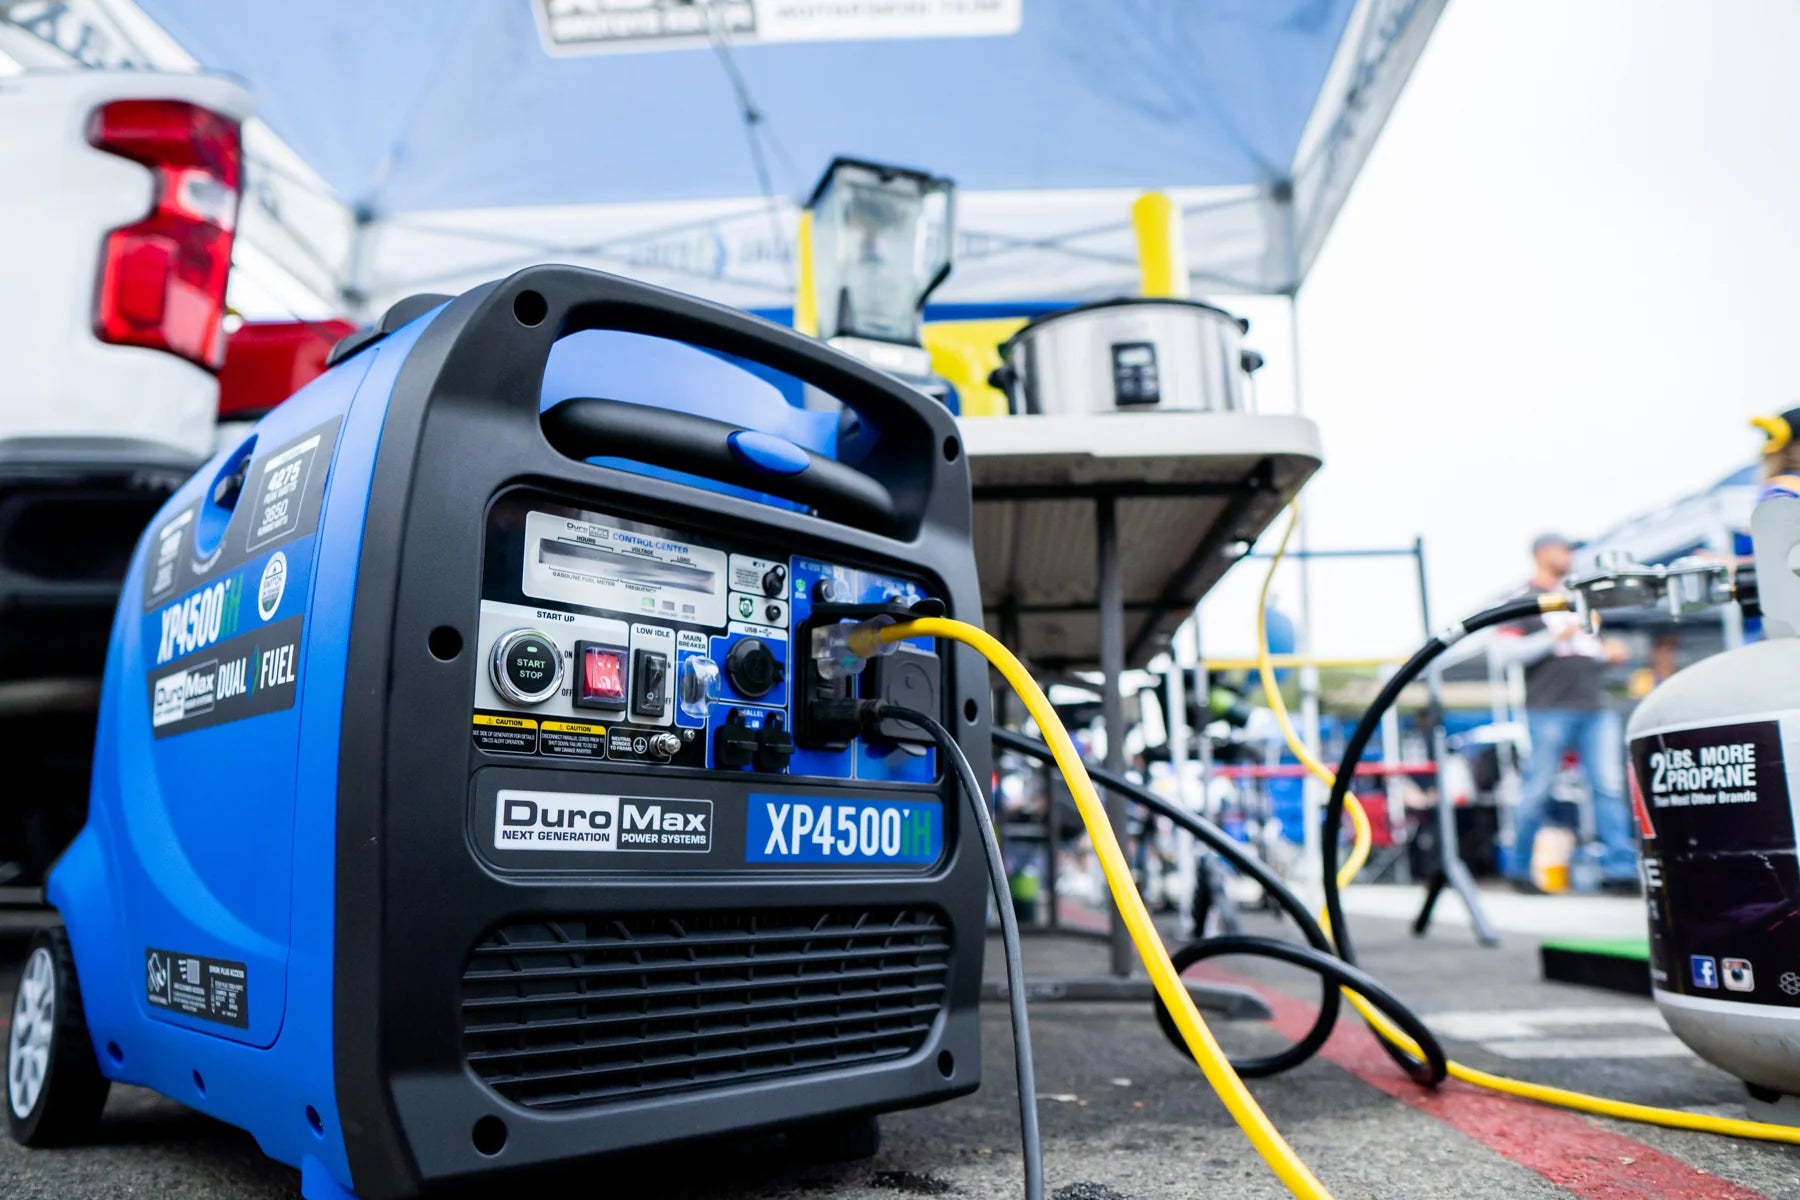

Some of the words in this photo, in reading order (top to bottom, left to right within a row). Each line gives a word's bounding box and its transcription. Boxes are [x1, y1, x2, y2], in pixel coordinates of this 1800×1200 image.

[268, 460, 302, 491] 4275
[576, 535, 596, 544] HOURS
[613, 532, 654, 548] CONTROL
[655, 543, 689, 555] CENTER
[552, 571, 581, 582] GASOLINE
[581, 576, 596, 584] FUEL
[596, 579, 616, 587] METER
[625, 584, 657, 593] FREQUENCY
[536, 610, 563, 621] START
[563, 613, 575, 623] UP
[636, 626, 653, 636] LOW
[654, 629, 670, 639] IDLE
[744, 626, 757, 634] USB
[682, 633, 702, 643] MAIN
[679, 640, 706, 650] BREAKER
[564, 650, 573, 659] ON
[260, 644, 295, 690] FUEL
[516, 658, 546, 669] START
[216, 657, 247, 701] DUAL
[519, 669, 543, 680] STOP
[185, 672, 215, 698] Max
[495, 718, 523, 727] CAUTION
[565, 724, 592, 733] CAUTION
[1650, 752, 1667, 793] 2
[1700, 743, 1756, 766] MORE
[1667, 763, 1757, 792] PROPANE
[1691, 792, 1716, 806] Other
[1718, 789, 1757, 804] Brands
[503, 799, 612, 829] Duro
[622, 804, 706, 832] Max
[502, 830, 535, 841] NEXT
[537, 831, 610, 842] GENERATION
[621, 833, 658, 844] POWER
[661, 834, 706, 845] SYSTEMS
